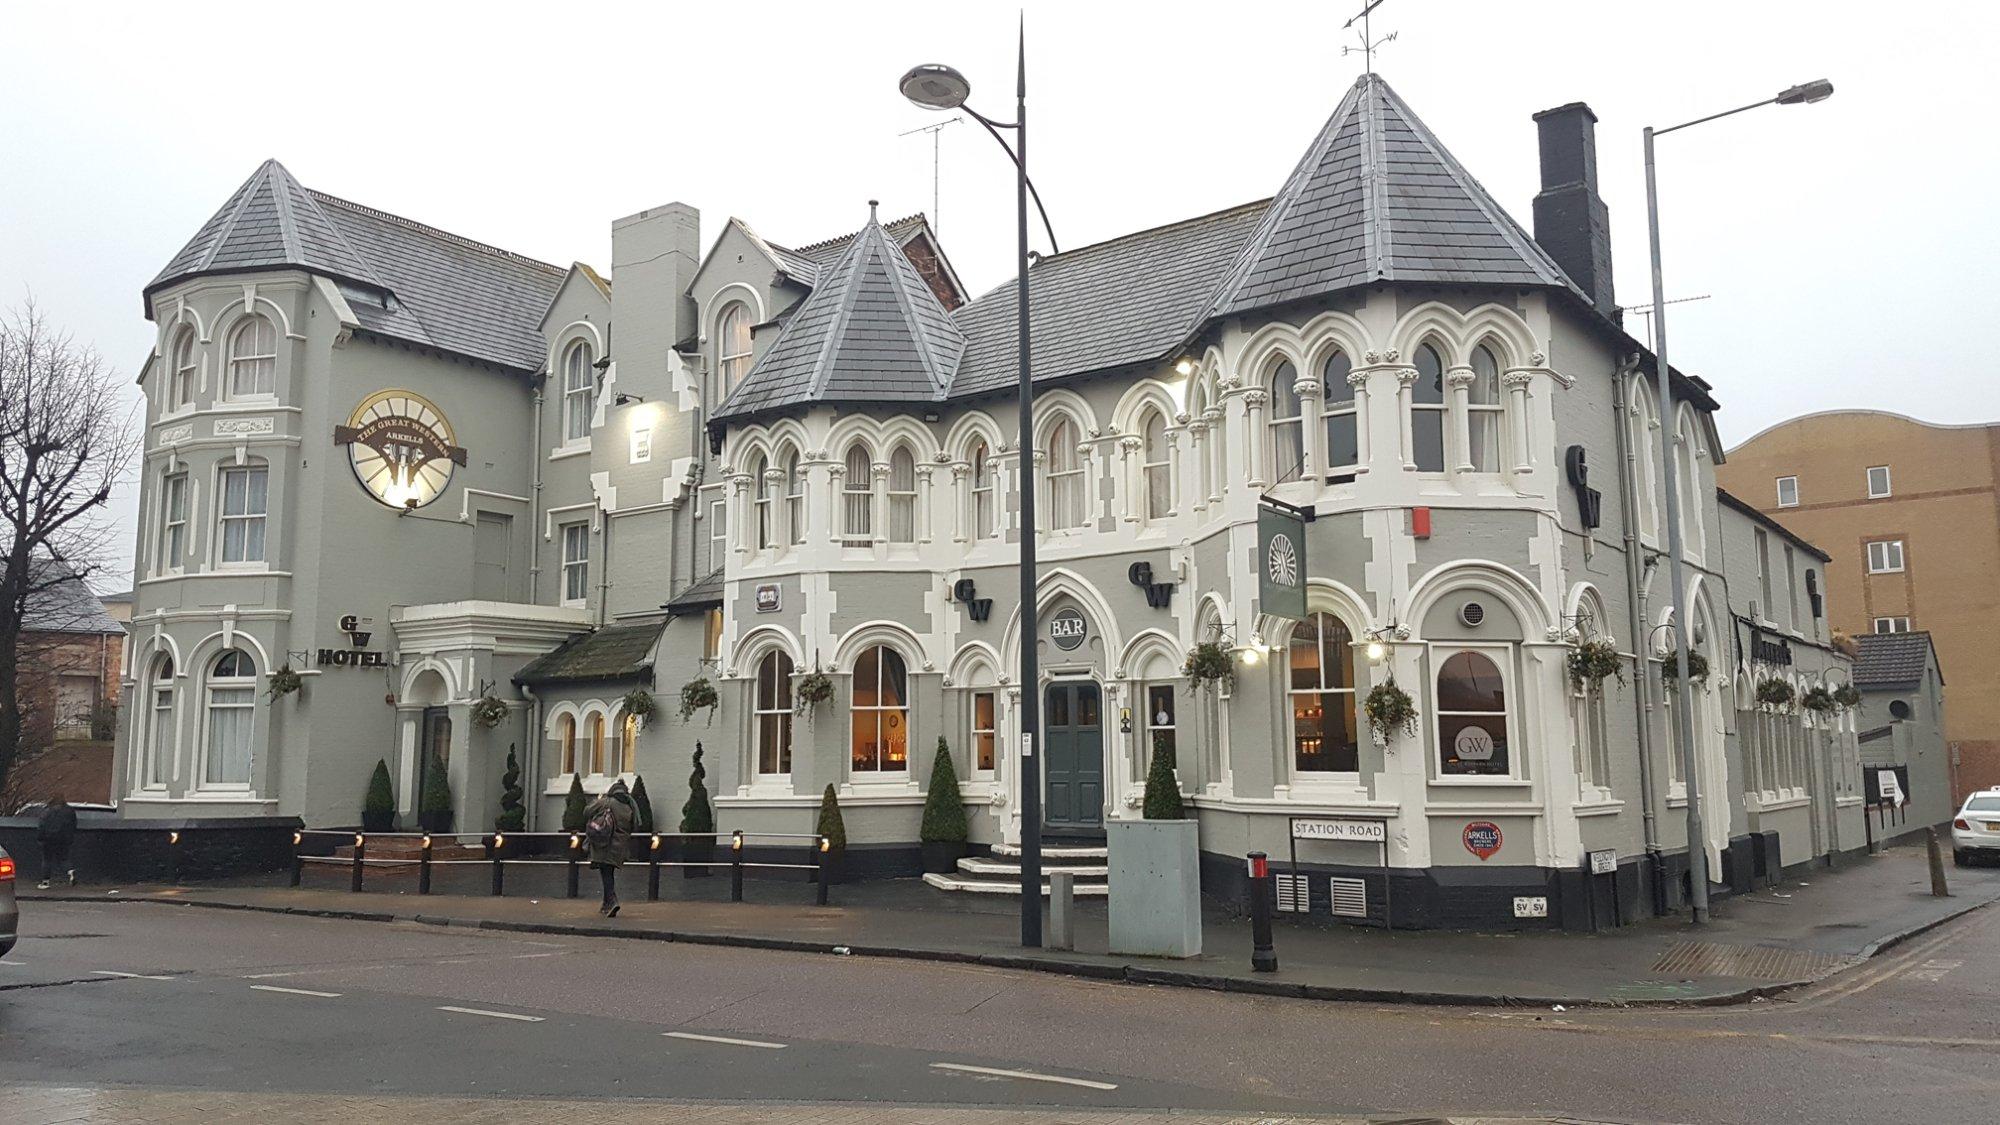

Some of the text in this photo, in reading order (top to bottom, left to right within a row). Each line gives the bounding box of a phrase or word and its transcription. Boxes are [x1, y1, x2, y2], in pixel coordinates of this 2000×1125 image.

[357, 418, 450, 458] THE GREAT WESTERN
[385, 431, 424, 444] ARKELLS
[1052, 619, 1085, 636] BAR
[317, 648, 388, 667] HOTEL
[1458, 736, 1488, 753] GW
[1294, 823, 1382, 837] STATION ROAD
[1467, 831, 1498, 840] ARKELLS
[1516, 903, 1545, 911] SV SV
